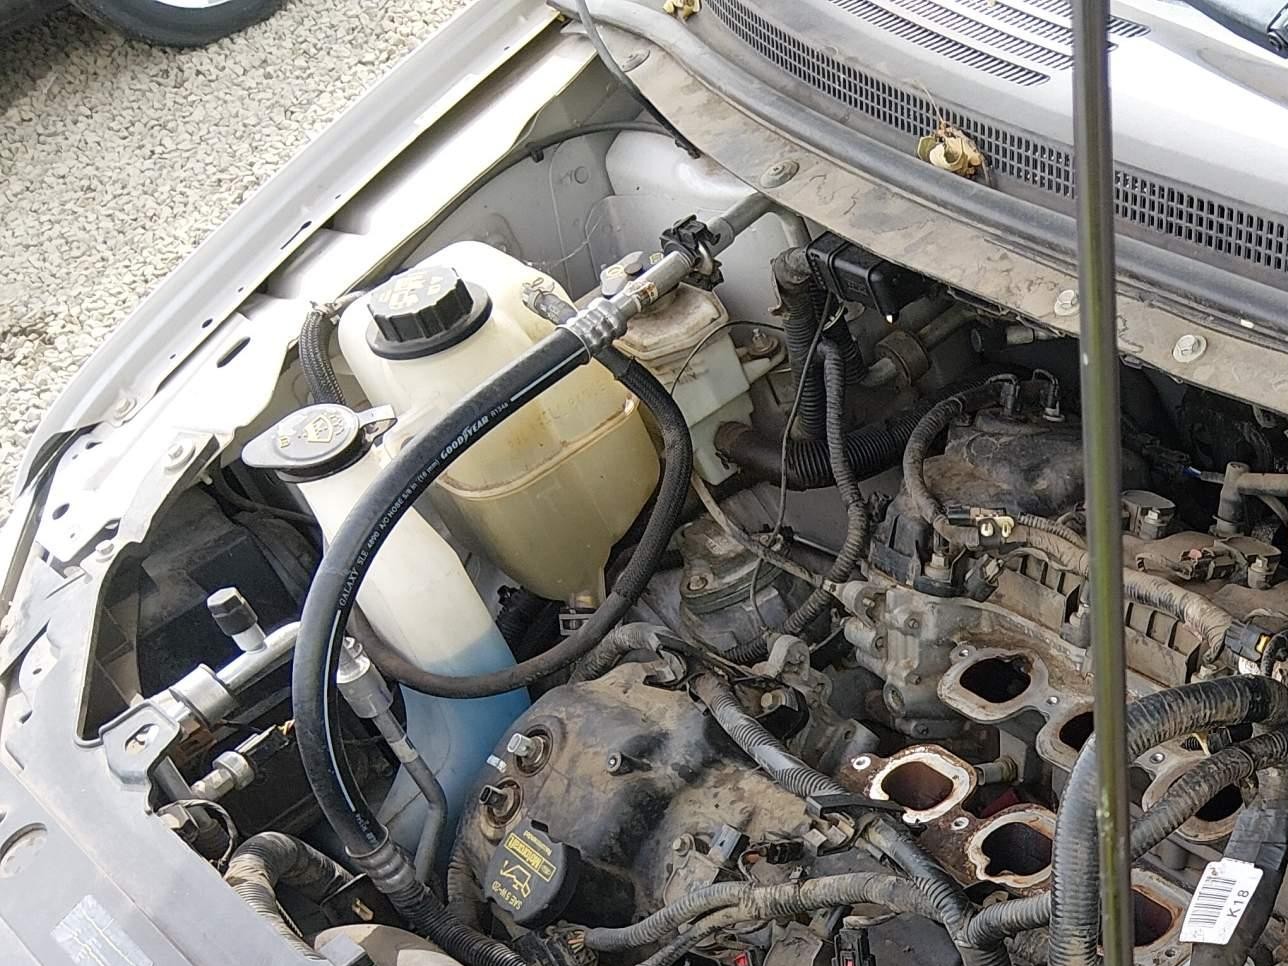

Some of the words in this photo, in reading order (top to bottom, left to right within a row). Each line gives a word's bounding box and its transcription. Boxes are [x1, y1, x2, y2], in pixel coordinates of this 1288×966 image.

[339, 567, 360, 607] GALAXY
[357, 550, 369, 567] SLE
[388, 497, 404, 518] HOSE
[440, 415, 489, 460] GOODYEAR
[508, 895, 522, 910] SAE
[1227, 889, 1250, 918] K18
